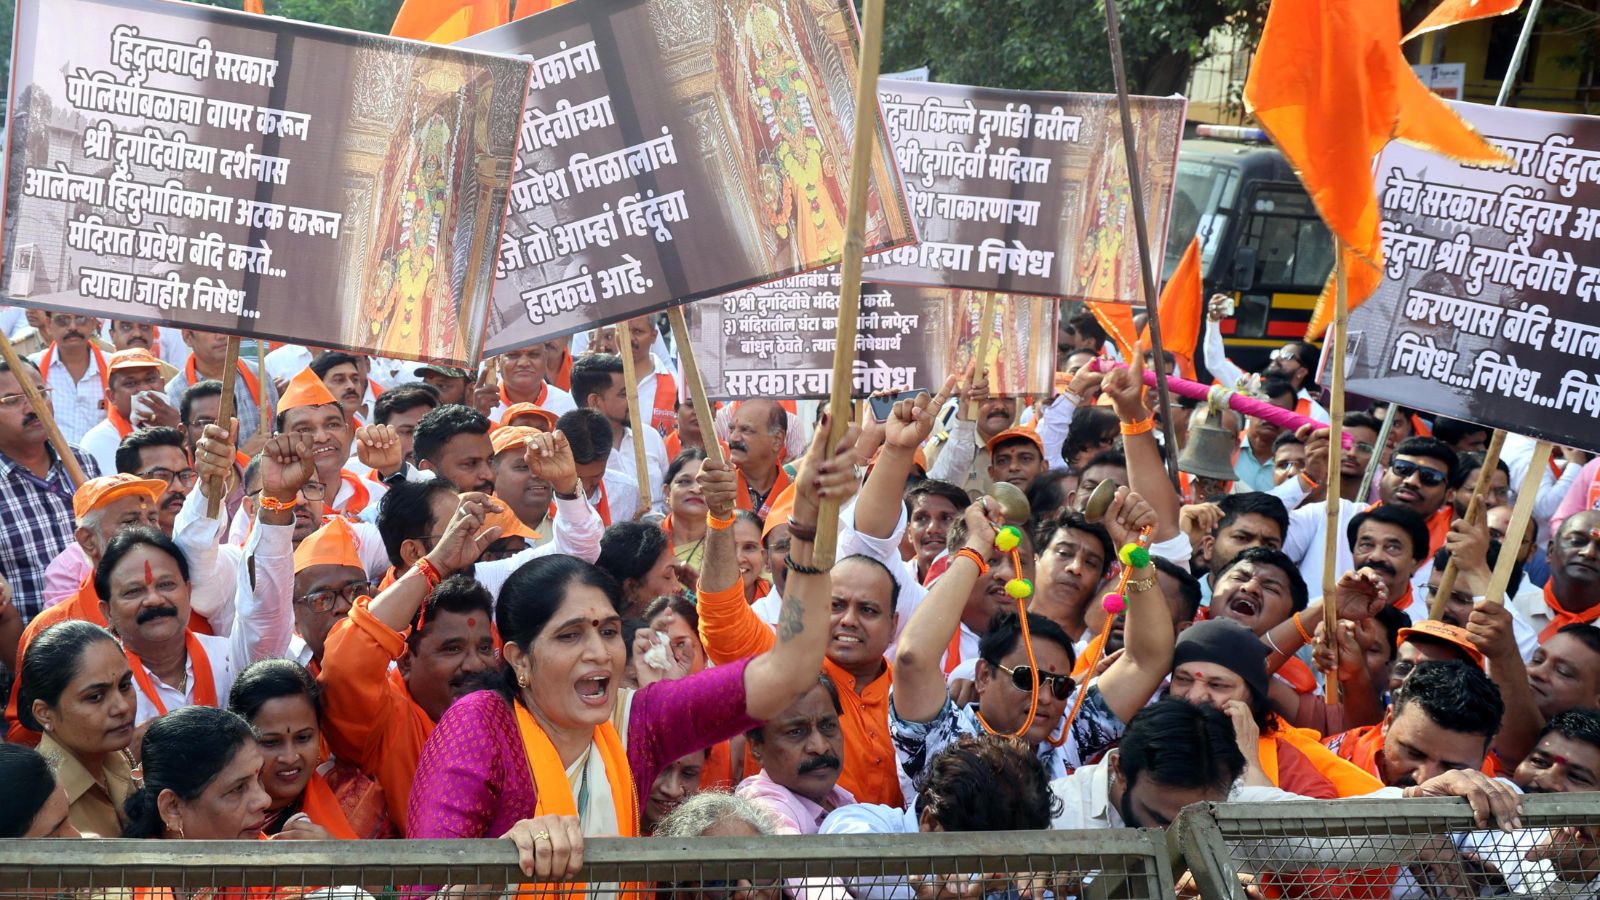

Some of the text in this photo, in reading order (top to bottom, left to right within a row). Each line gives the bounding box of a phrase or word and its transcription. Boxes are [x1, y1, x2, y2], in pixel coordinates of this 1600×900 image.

[111, 26, 279, 87] हिंदुत्ववादी सरकार
[67, 69, 311, 141] पोलिसीबळाचा वापर करून
[922, 97, 977, 134] किल्ले
[979, 103, 1032, 148] दुर्गाडी
[1034, 106, 1082, 142] वरील
[84, 120, 290, 185] श्री दुर्गादेवीच्या दर्शनास
[921, 141, 987, 188] दुर्गादेवी
[989, 148, 1051, 184] मंदिरात
[24, 164, 342, 239] आलेल्या हिंदुभाविकांना अटक करून
[511, 166, 570, 213] प्रवेश
[1384, 168, 1422, 213] तेच
[1421, 185, 1499, 226] सरकार
[1569, 206, 1600, 241] अ
[68, 215, 287, 278] मंदिरात प्रवेश बंदि करते...
[522, 223, 554, 265] तो
[978, 239, 1054, 278] निषेध
[1433, 233, 1470, 275] श्री
[1467, 243, 1577, 295] दुर्गादेवीचे
[81, 268, 260, 319] त्याचा जाहीर निषेध...
[597, 253, 654, 299] आहे.
[739, 292, 756, 311] श्री
[757, 291, 811, 316] दुर्गादेवीचे
[739, 314, 796, 333] मंदिरातील
[799, 314, 820, 331] घंटा
[881, 311, 919, 334] लपेटून
[1405, 291, 1504, 338] करण्यास
[1502, 302, 1552, 351] बंदि
[740, 337, 774, 358] बांधून
[725, 368, 834, 396] सरकारचा
